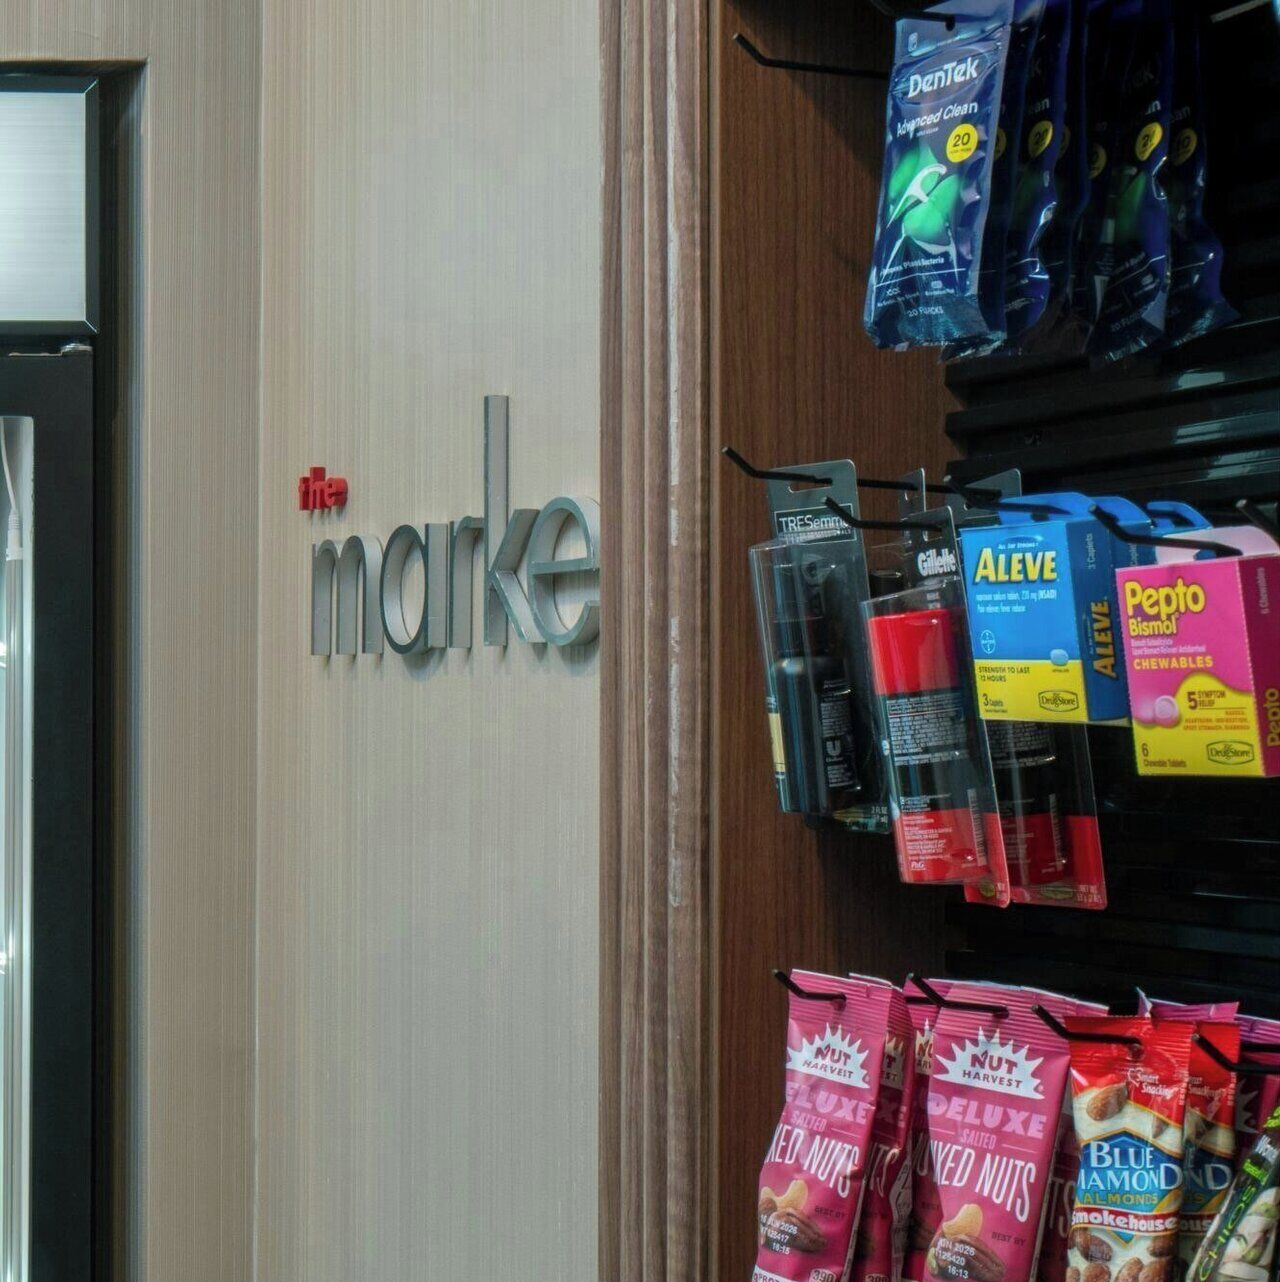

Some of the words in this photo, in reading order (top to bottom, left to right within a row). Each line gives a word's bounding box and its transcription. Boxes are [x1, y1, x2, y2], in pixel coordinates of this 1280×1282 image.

[908, 57, 979, 98] DenTek
[943, 102, 978, 120] Clean
[953, 132, 971, 147] 20
[299, 467, 348, 511] the
[917, 548, 956, 577] Gillette
[975, 547, 1057, 583] ALEVE
[1124, 578, 1205, 619] Pepto
[1128, 617, 1177, 636] Bismol
[1092, 600, 1116, 679] ALEVE
[1133, 656, 1213, 669] CHEWABLES
[1187, 691, 1198, 709] 5
[814, 1044, 851, 1066] NUT
[970, 1050, 1018, 1075] NUT
[802, 1059, 854, 1078] HARVEST
[962, 1070, 1023, 1089] HARVEST
[792, 1110, 827, 1132] SALTED
[928, 1092, 1047, 1139] DELUXE
[960, 1129, 997, 1150] SALTED
[803, 1135, 860, 1198] NUTS
[1091, 1141, 1154, 1169] BLUE
[975, 1153, 1036, 1222] NUTS
[1079, 1163, 1183, 1190] IAMOND
[1084, 1193, 1158, 1205] ALMONDS
[1072, 1210, 1178, 1231] Smokehouse
